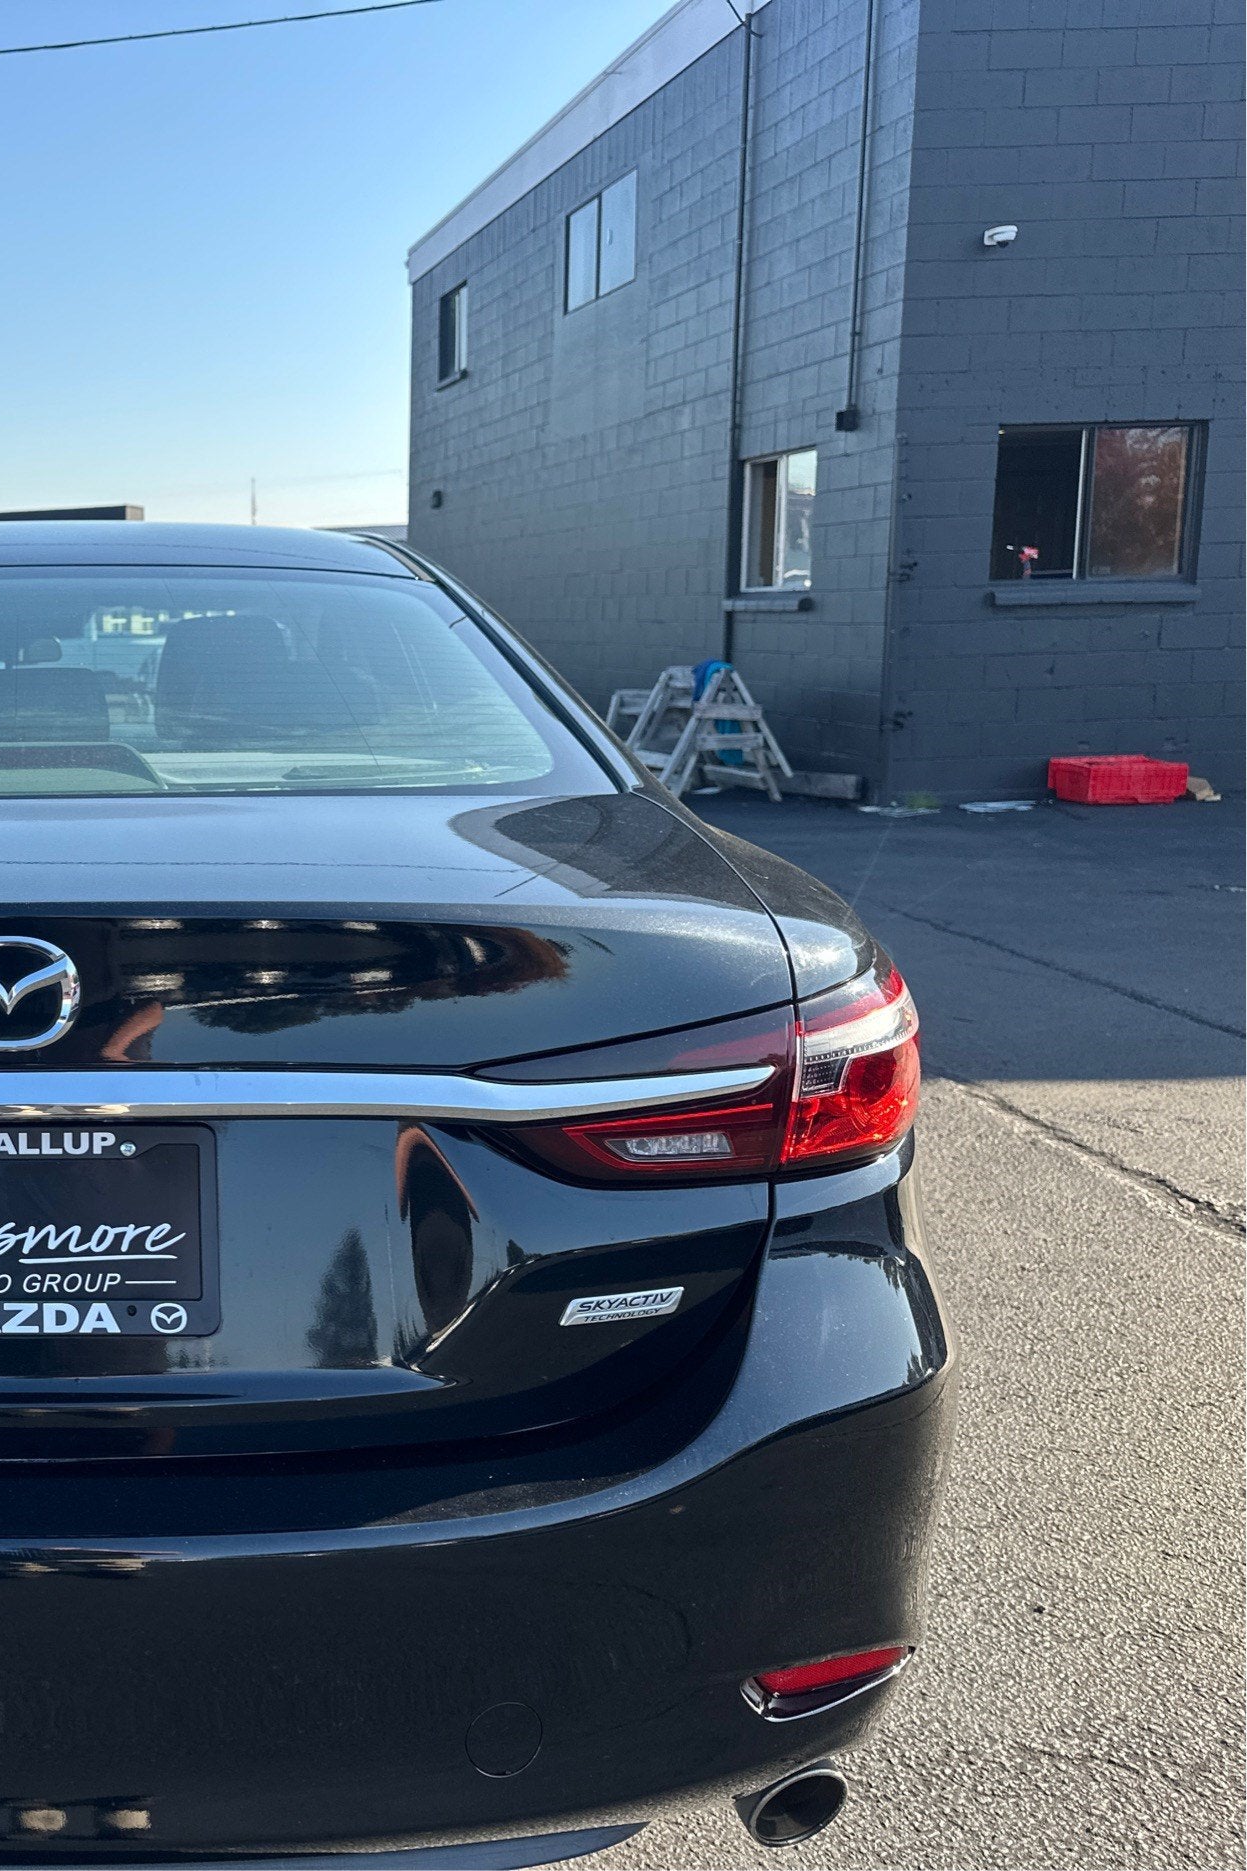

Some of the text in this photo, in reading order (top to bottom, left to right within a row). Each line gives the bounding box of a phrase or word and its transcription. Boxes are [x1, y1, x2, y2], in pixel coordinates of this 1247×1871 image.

[22, 1272, 122, 1293] GROUP
[577, 1292, 674, 1312] SKYACTIV
[583, 1308, 663, 1323] TECHNOLOGY
